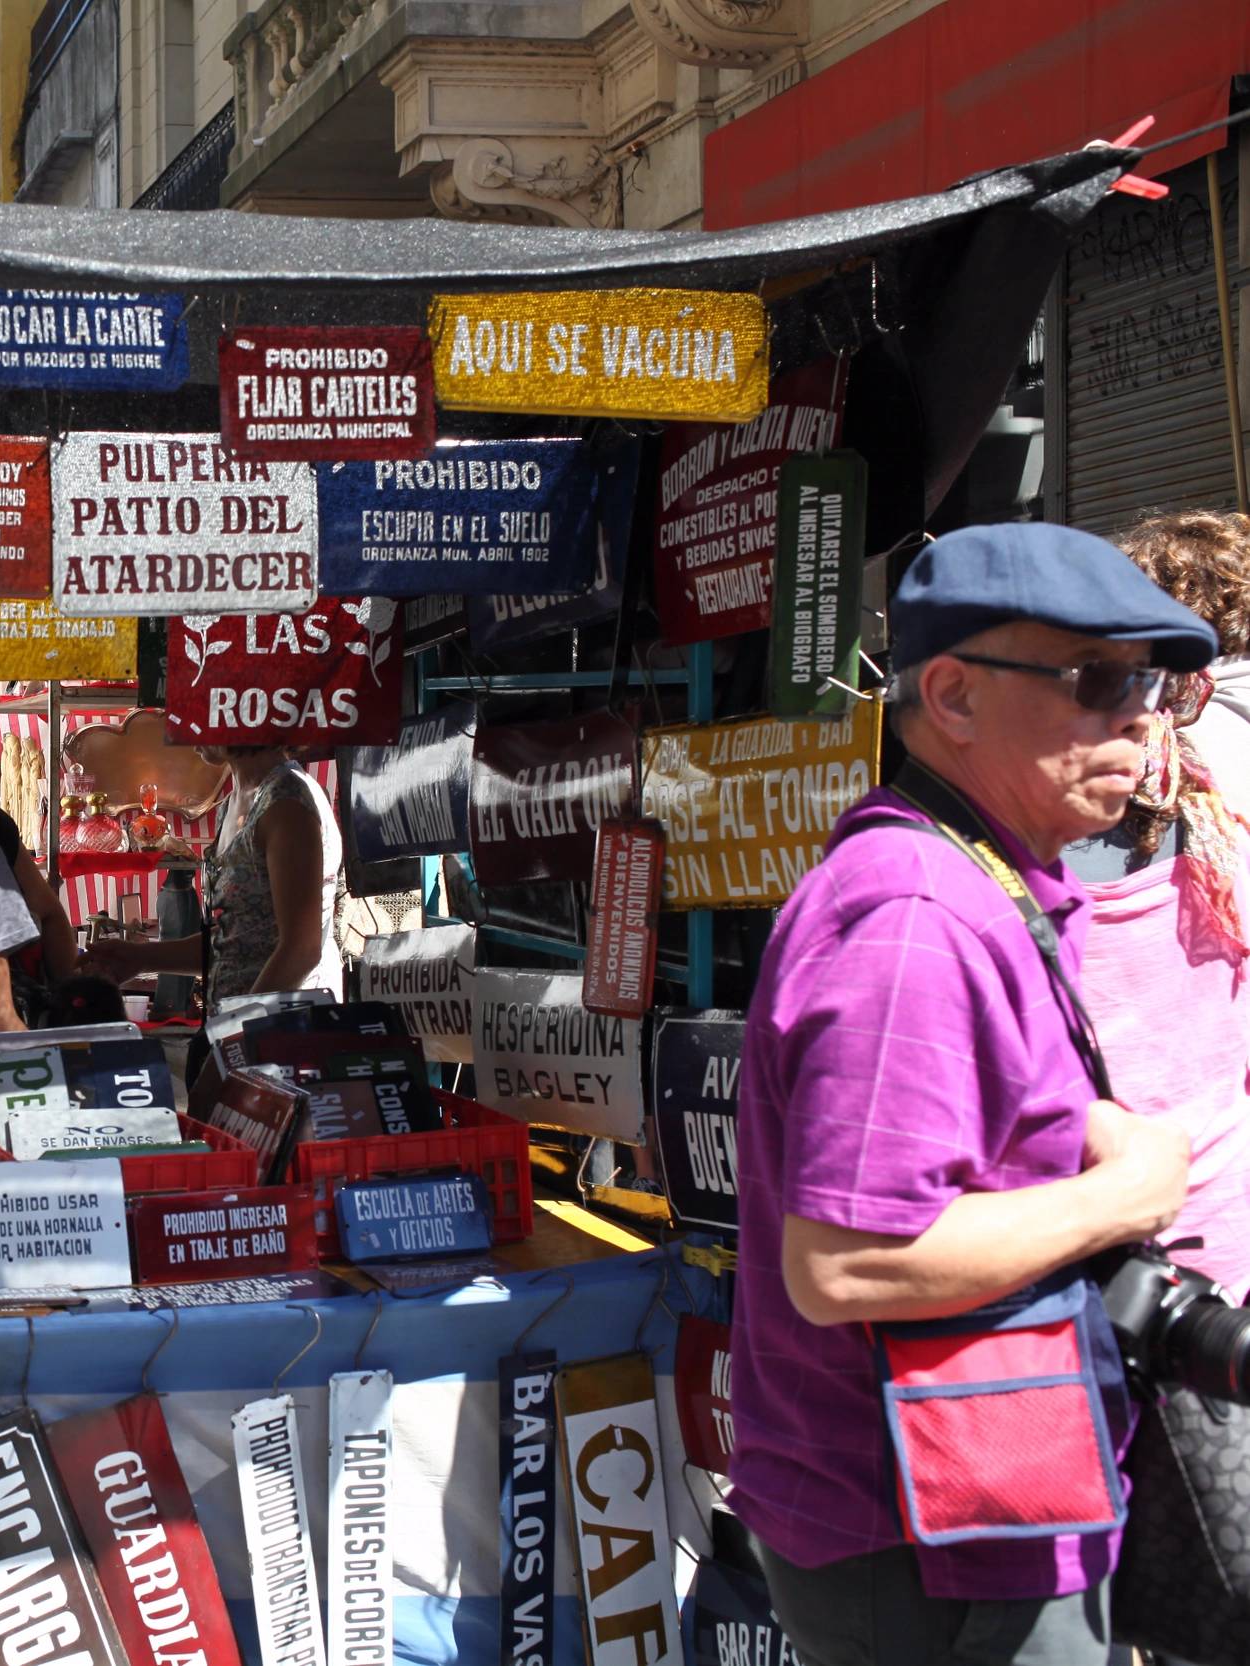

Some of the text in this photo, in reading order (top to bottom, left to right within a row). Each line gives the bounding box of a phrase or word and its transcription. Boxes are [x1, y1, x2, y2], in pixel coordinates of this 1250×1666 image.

[64, 306, 91, 345] LA
[95, 306, 165, 347] CARNE
[24, 352, 86, 369] RAZONES
[90, 353, 107, 369] DE
[111, 354, 162, 369] HIGIENE
[265, 348, 388, 370] PROHIBIDO
[450, 315, 736, 383] AQUI SE VACUNA
[238, 375, 417, 418] FIJAR CARTELES
[247, 421, 413, 441] ORDENANZA MUNICIPAL
[375, 460, 541, 490] PROHIBIDO
[661, 431, 718, 512] BORRON
[696, 468, 768, 506] DESPACHO
[70, 495, 303, 536] PATIO DEL
[362, 510, 550, 543] ESCUPIR EN EL SUELO
[660, 502, 736, 549] COMESTIBLES
[362, 547, 549, 561] ORDENANZA ABRIL 1902
[686, 534, 735, 569] BEBIDAS
[62, 552, 314, 595] ATARDECER
[816, 494, 842, 673] QUITARSE SOMBRERO
[791, 507, 817, 683] INGRESAR BIOGRAFO
[55, 621, 116, 638] TRABAJO
[246, 613, 331, 655] LAS
[209, 687, 359, 732] ROSAS
[510, 752, 623, 839] GALPON
[719, 759, 870, 840] AL FONDO
[663, 853, 712, 899] SIN
[605, 850, 629, 984] BIENVENIDOS
[618, 836, 653, 1000] ALCOHOLICOS ANONIMOS
[370, 956, 462, 996] PROHIBIDA
[402, 998, 472, 1036] NTRADA
[482, 1002, 625, 1057] HESPERIDINA
[493, 1067, 612, 1106] BAGLEY
[63, 1136, 154, 1148] DAN ENVASES
[65, 1125, 125, 1136] NO
[58, 1194, 99, 1210] USAR
[163, 1204, 287, 1237] PROHIBIDO INGRESAR
[353, 1183, 476, 1221] ESCUELA DE ARTES
[0, 1222, 13, 1238] DE
[15, 1220, 41, 1236] UNA
[44, 1216, 103, 1235] HORNALLA
[169, 1228, 285, 1264] EN TRAJE DE BAÑO
[400, 1219, 456, 1249] OFICIOS
[17, 1238, 92, 1259] HABITACION
[249, 1415, 300, 1536] PROHIBIDO
[344, 1429, 387, 1556] TAPONES
[513, 1373, 547, 1583] BAR LOS
